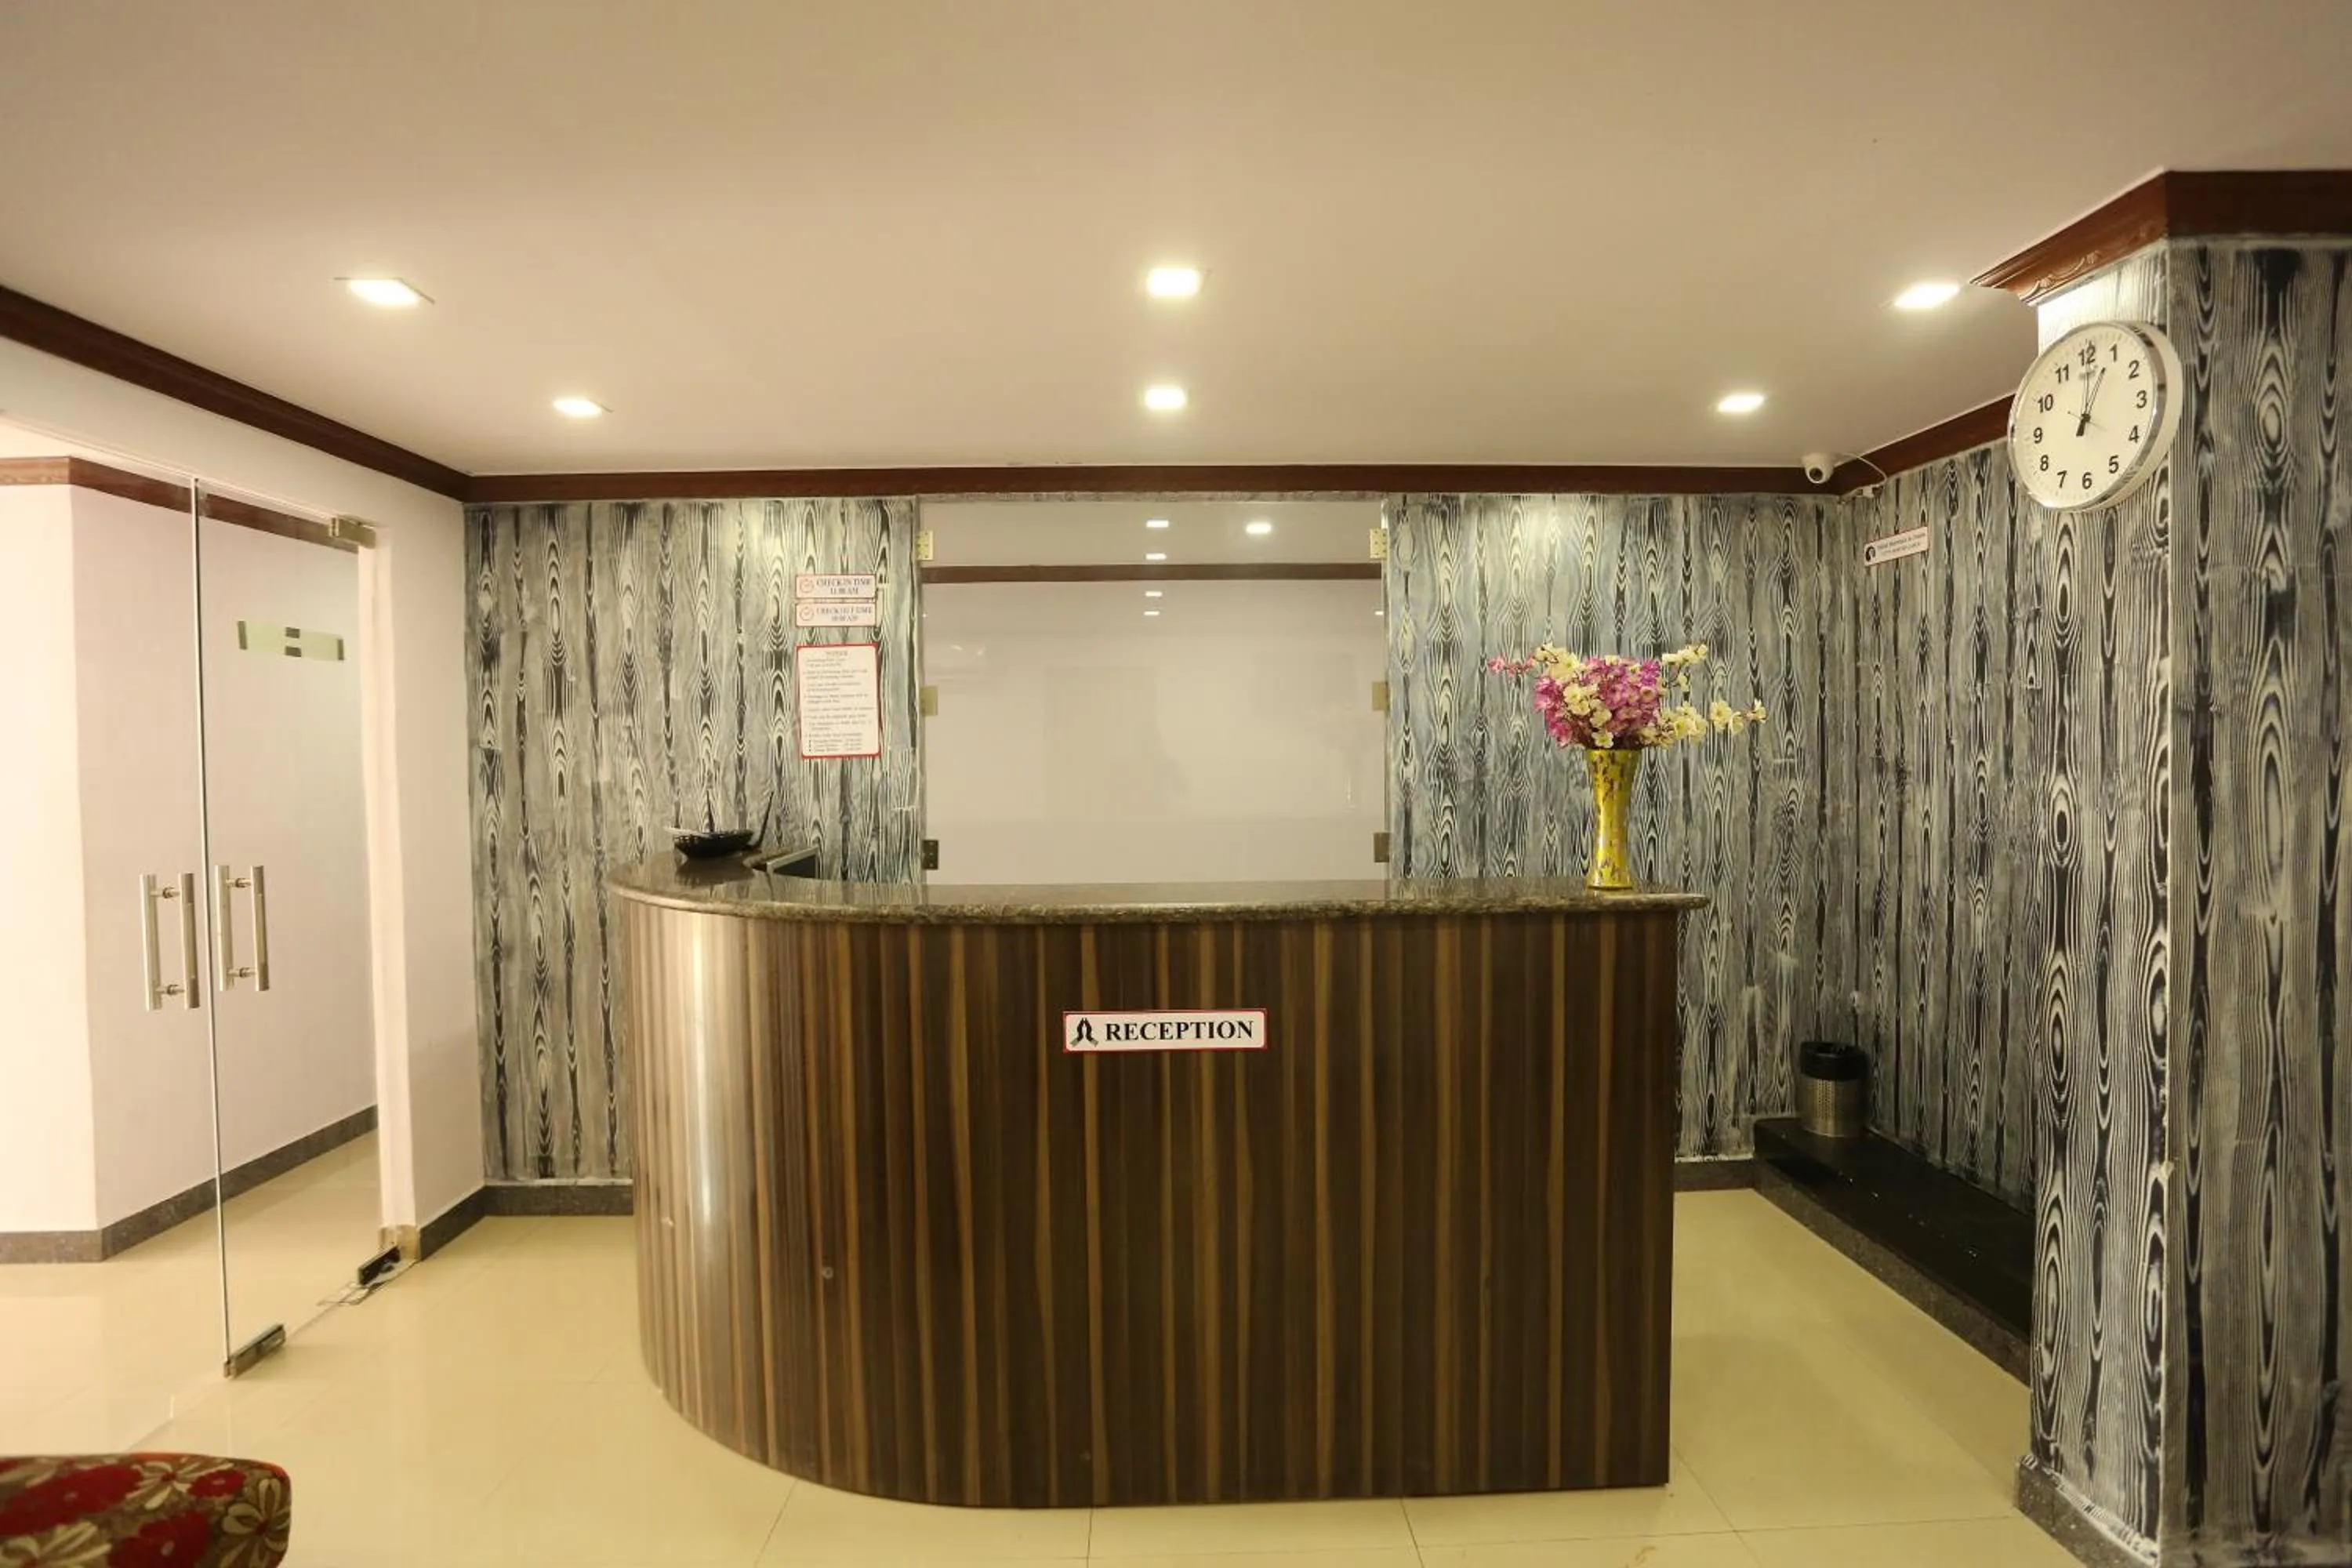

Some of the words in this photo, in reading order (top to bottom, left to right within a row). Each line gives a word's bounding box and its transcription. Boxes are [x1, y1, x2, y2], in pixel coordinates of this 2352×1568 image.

[2078, 344, 2096, 366] 12
[2109, 343, 2118, 362] 1
[2055, 364, 2070, 383] 11
[2128, 360, 2140, 379] 2
[2038, 394, 2053, 413] 10
[2136, 390, 2147, 408] 3
[2033, 427, 2043, 444] 9
[2128, 425, 2140, 444] 4
[2039, 455, 2049, 471] 8
[2108, 455, 2119, 474] 5
[2057, 470, 2067, 488] 7
[2082, 472, 2092, 489] 6
[1105, 1020, 1254, 1041] RECEPTION
